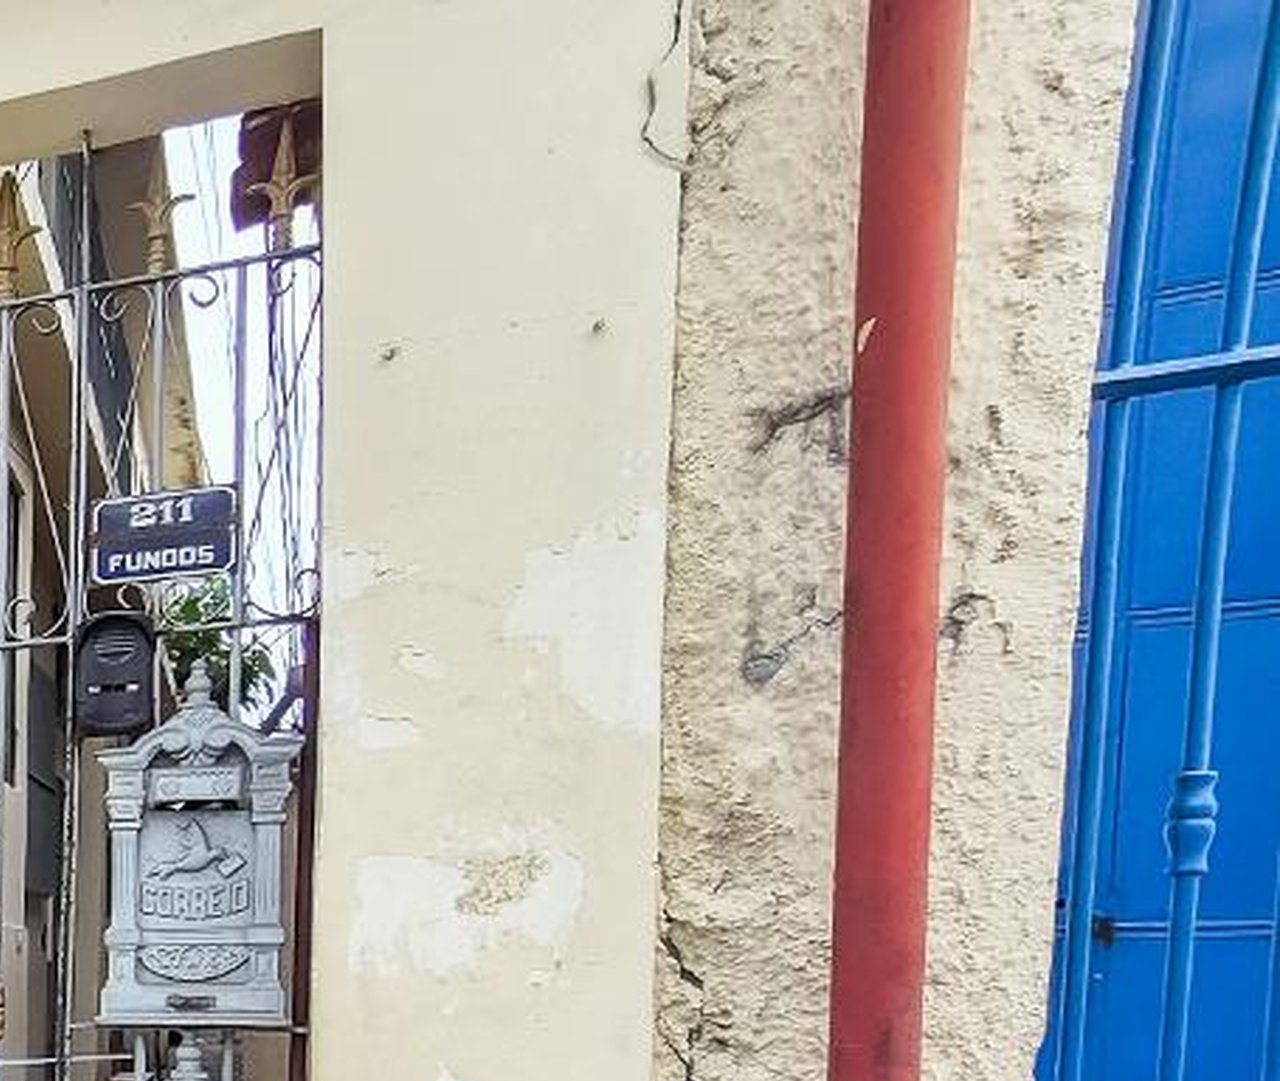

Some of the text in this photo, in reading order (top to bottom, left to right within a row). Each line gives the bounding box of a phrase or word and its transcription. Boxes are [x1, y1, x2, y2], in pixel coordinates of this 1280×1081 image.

[130, 497, 194, 528] 211
[108, 545, 215, 573] FUNDOS
[141, 880, 251, 921] CORREIO
